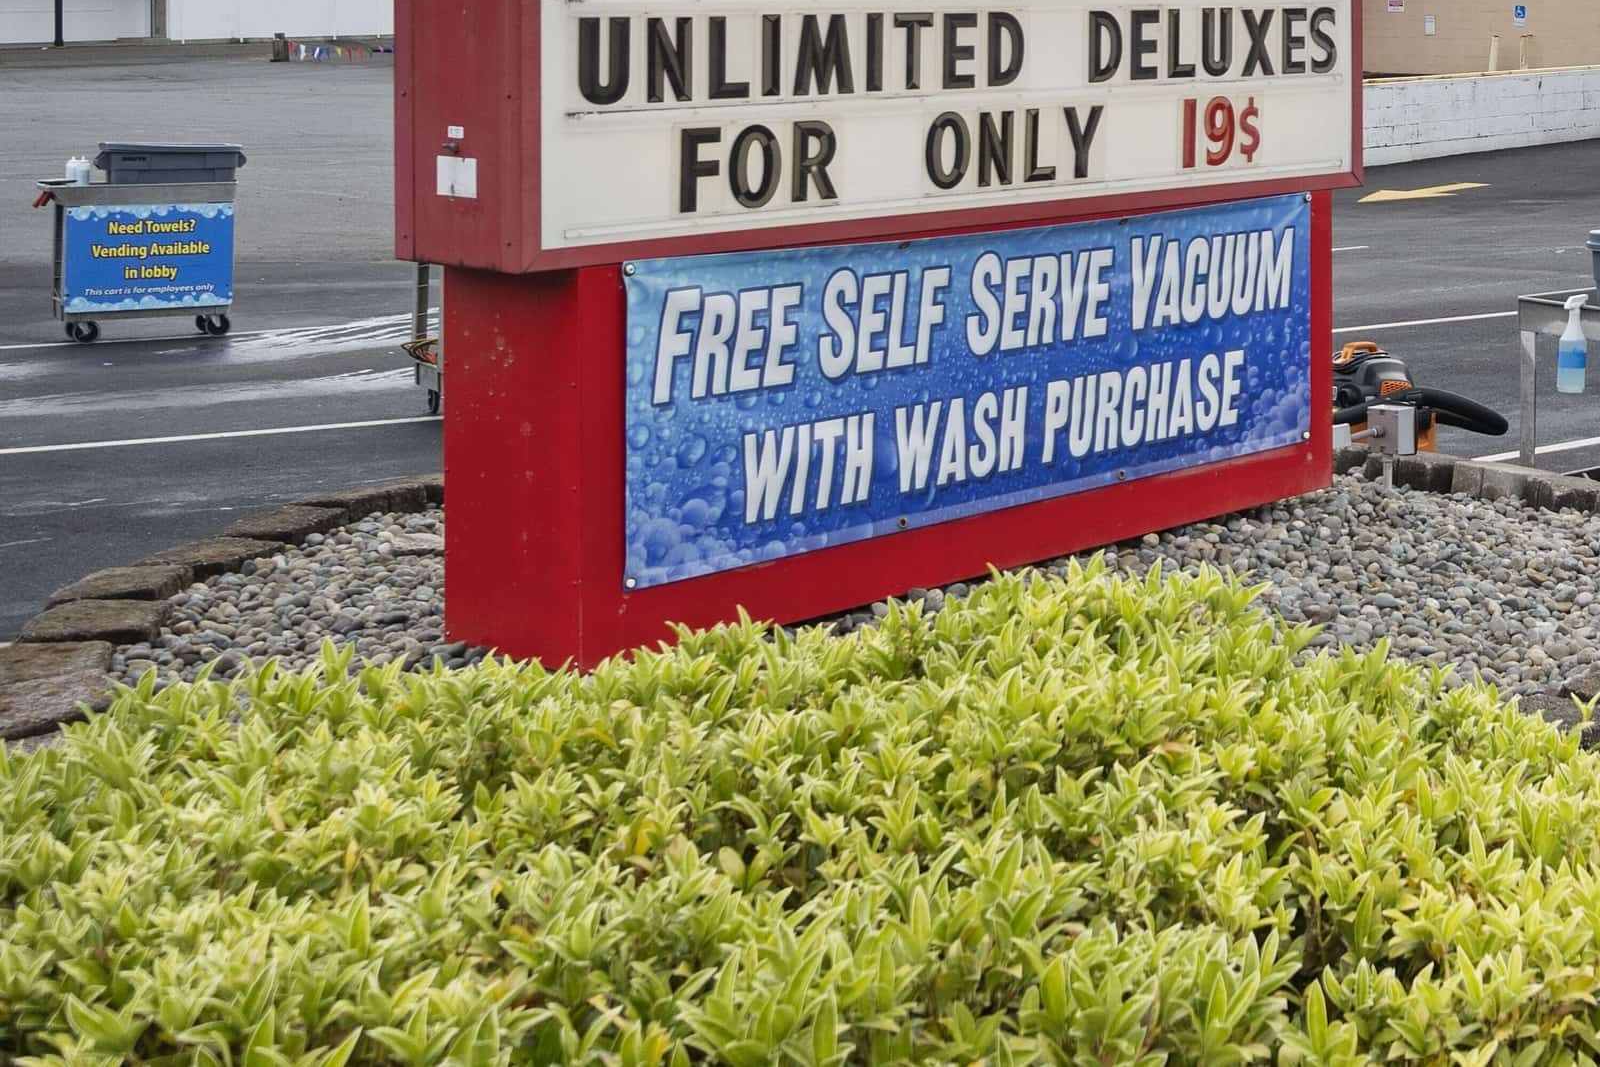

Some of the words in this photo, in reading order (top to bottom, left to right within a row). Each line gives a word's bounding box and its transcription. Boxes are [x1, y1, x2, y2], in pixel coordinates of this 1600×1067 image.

[578, 11, 1026, 105] UNLIMITED
[1088, 6, 1337, 83] DELUXES
[679, 119, 839, 214] FOR
[925, 104, 1105, 190] ONLY
[1182, 96, 1262, 169] 19$
[92, 244, 147, 259] Vending
[150, 242, 210, 255] Available
[108, 221, 143, 234] Need
[146, 219, 196, 232] Towels?
[85, 288, 102, 296] This
[104, 287, 122, 295] cart
[123, 287, 132, 295] is
[133, 286, 146, 294] for
[148, 285, 194, 294] employees
[195, 283, 215, 292] only
[125, 266, 137, 279] in
[141, 265, 178, 280] lobby
[652, 285, 802, 406] FREE
[818, 266, 951, 380] SELF
[966, 248, 1114, 357] SERVE
[1131, 227, 1296, 332] VACUUM
[742, 412, 876, 525] WITH
[895, 387, 1028, 493] WASH
[1042, 349, 1245, 464] PURCHASE
